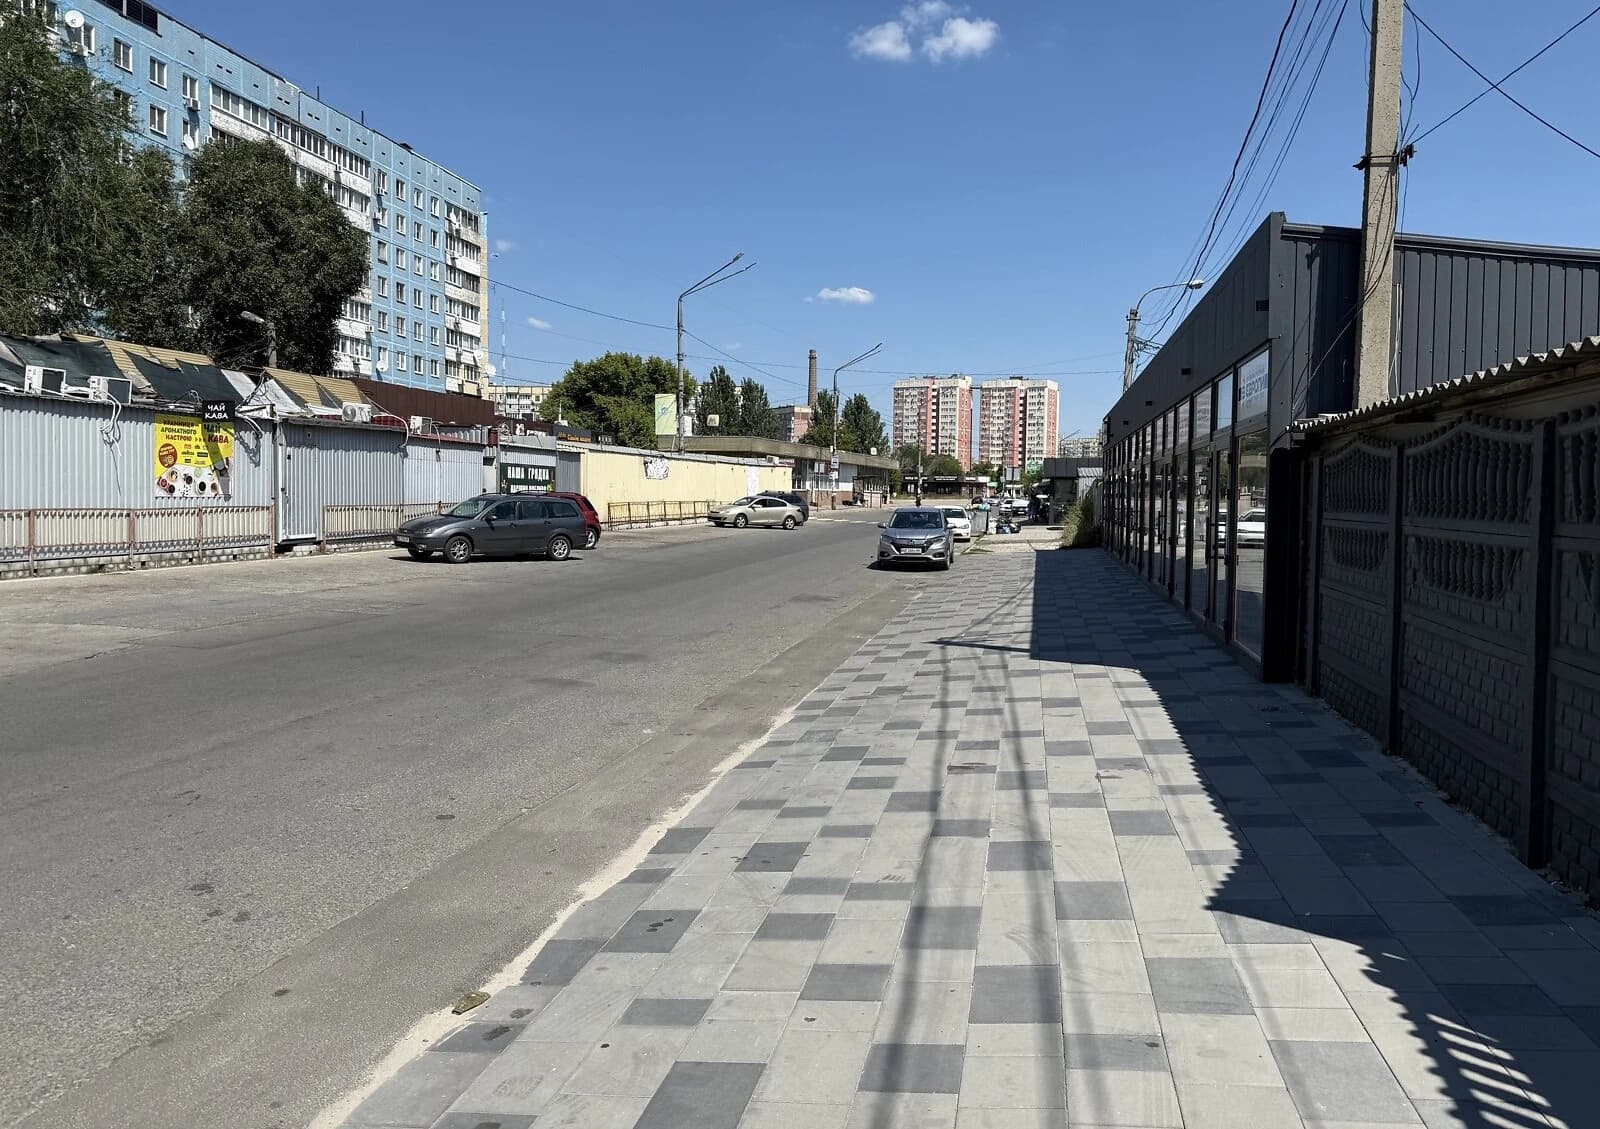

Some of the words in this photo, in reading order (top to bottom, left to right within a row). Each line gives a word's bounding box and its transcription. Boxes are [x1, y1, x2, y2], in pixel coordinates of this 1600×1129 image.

[207, 403, 226, 411] ЧАЙ
[160, 427, 197, 435] АРОМАТНОГО
[203, 422, 221, 433] ЧАЙ
[207, 434, 229, 444] КАВА
[507, 466, 525, 479] НАША
